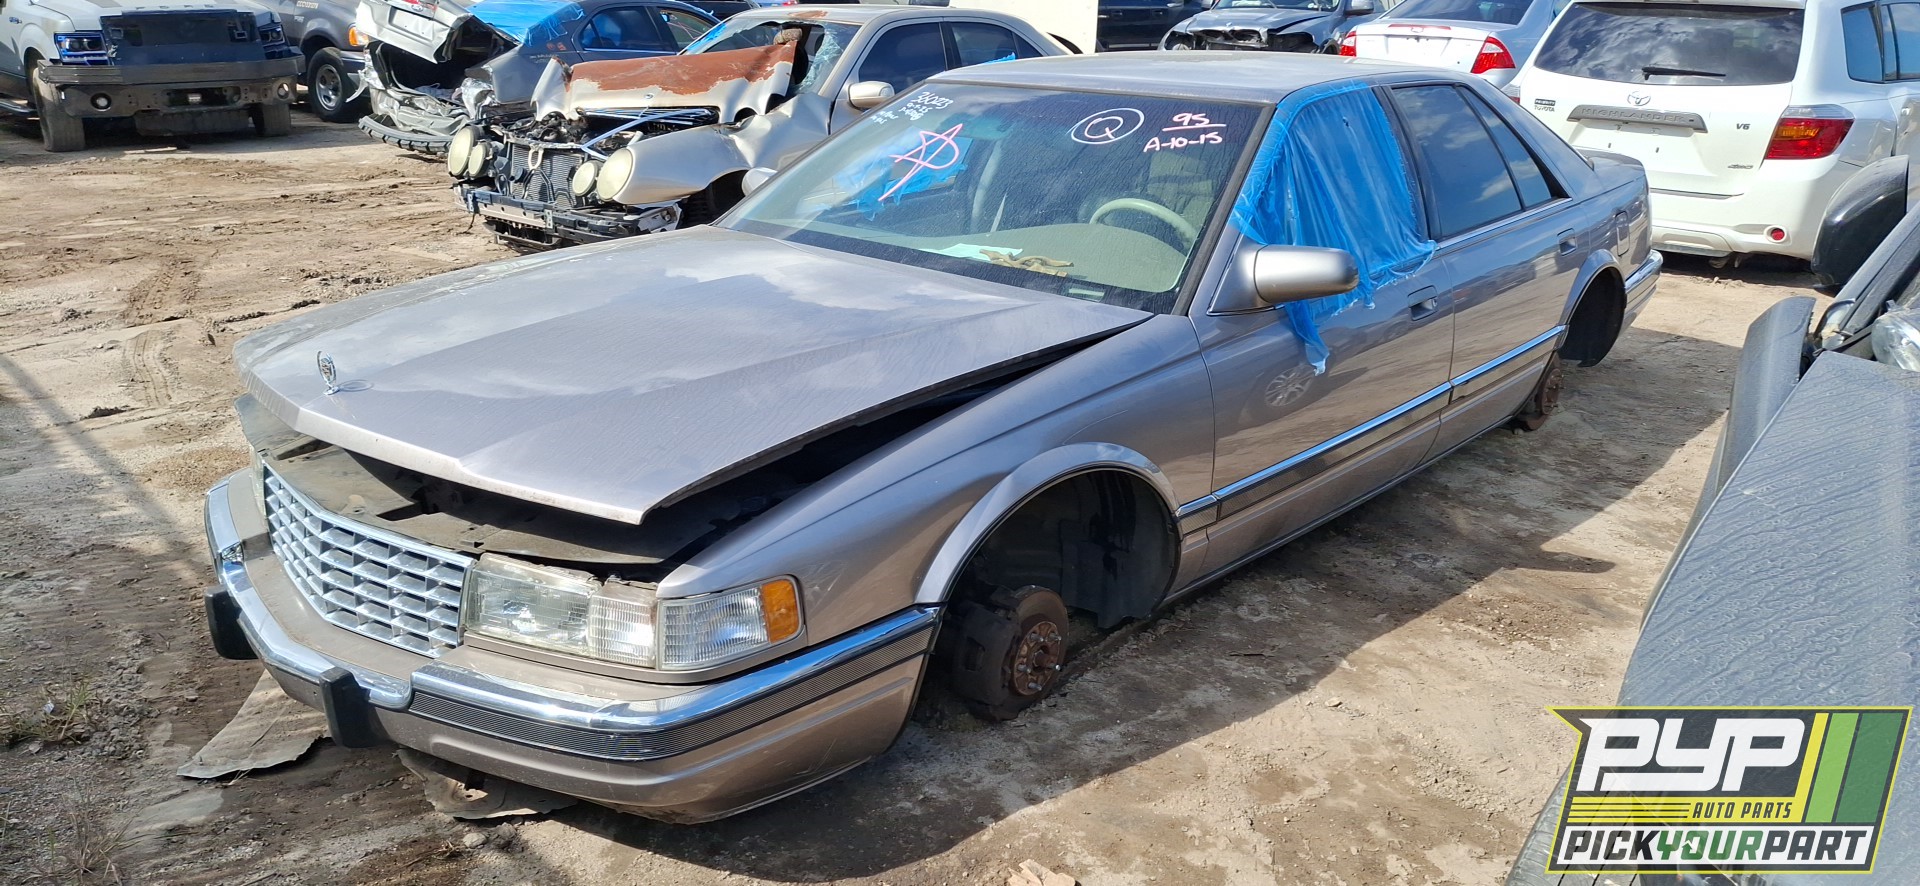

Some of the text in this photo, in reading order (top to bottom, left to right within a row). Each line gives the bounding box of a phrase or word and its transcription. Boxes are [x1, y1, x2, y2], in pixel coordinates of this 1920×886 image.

[1172, 112, 1210, 126] 95
[1581, 108, 1685, 122] HIGHLANDER
[1084, 116, 1124, 139] Q
[1143, 131, 1223, 153] A-10-15
